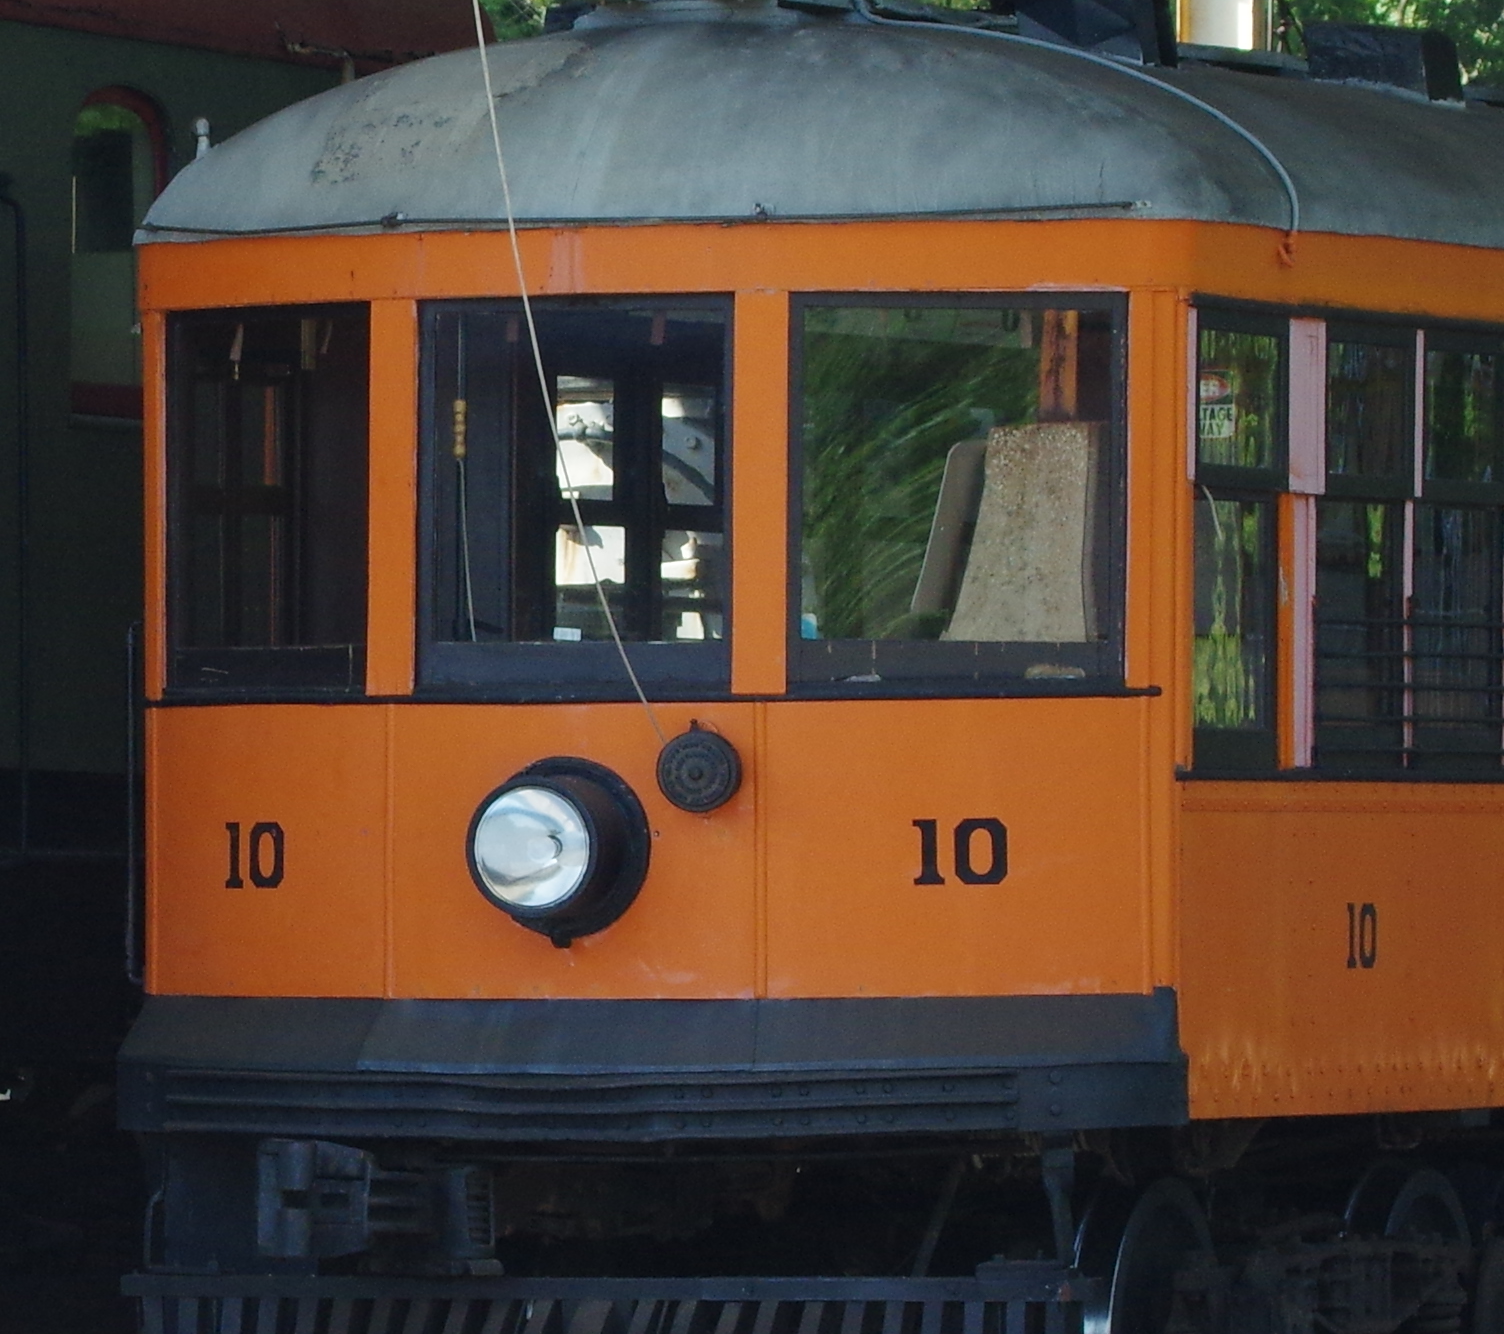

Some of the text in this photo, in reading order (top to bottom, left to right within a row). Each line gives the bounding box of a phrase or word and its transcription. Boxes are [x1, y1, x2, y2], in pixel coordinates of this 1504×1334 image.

[223, 822, 285, 889] 10
[912, 817, 1009, 887] 10
[1345, 902, 1378, 971] 10
